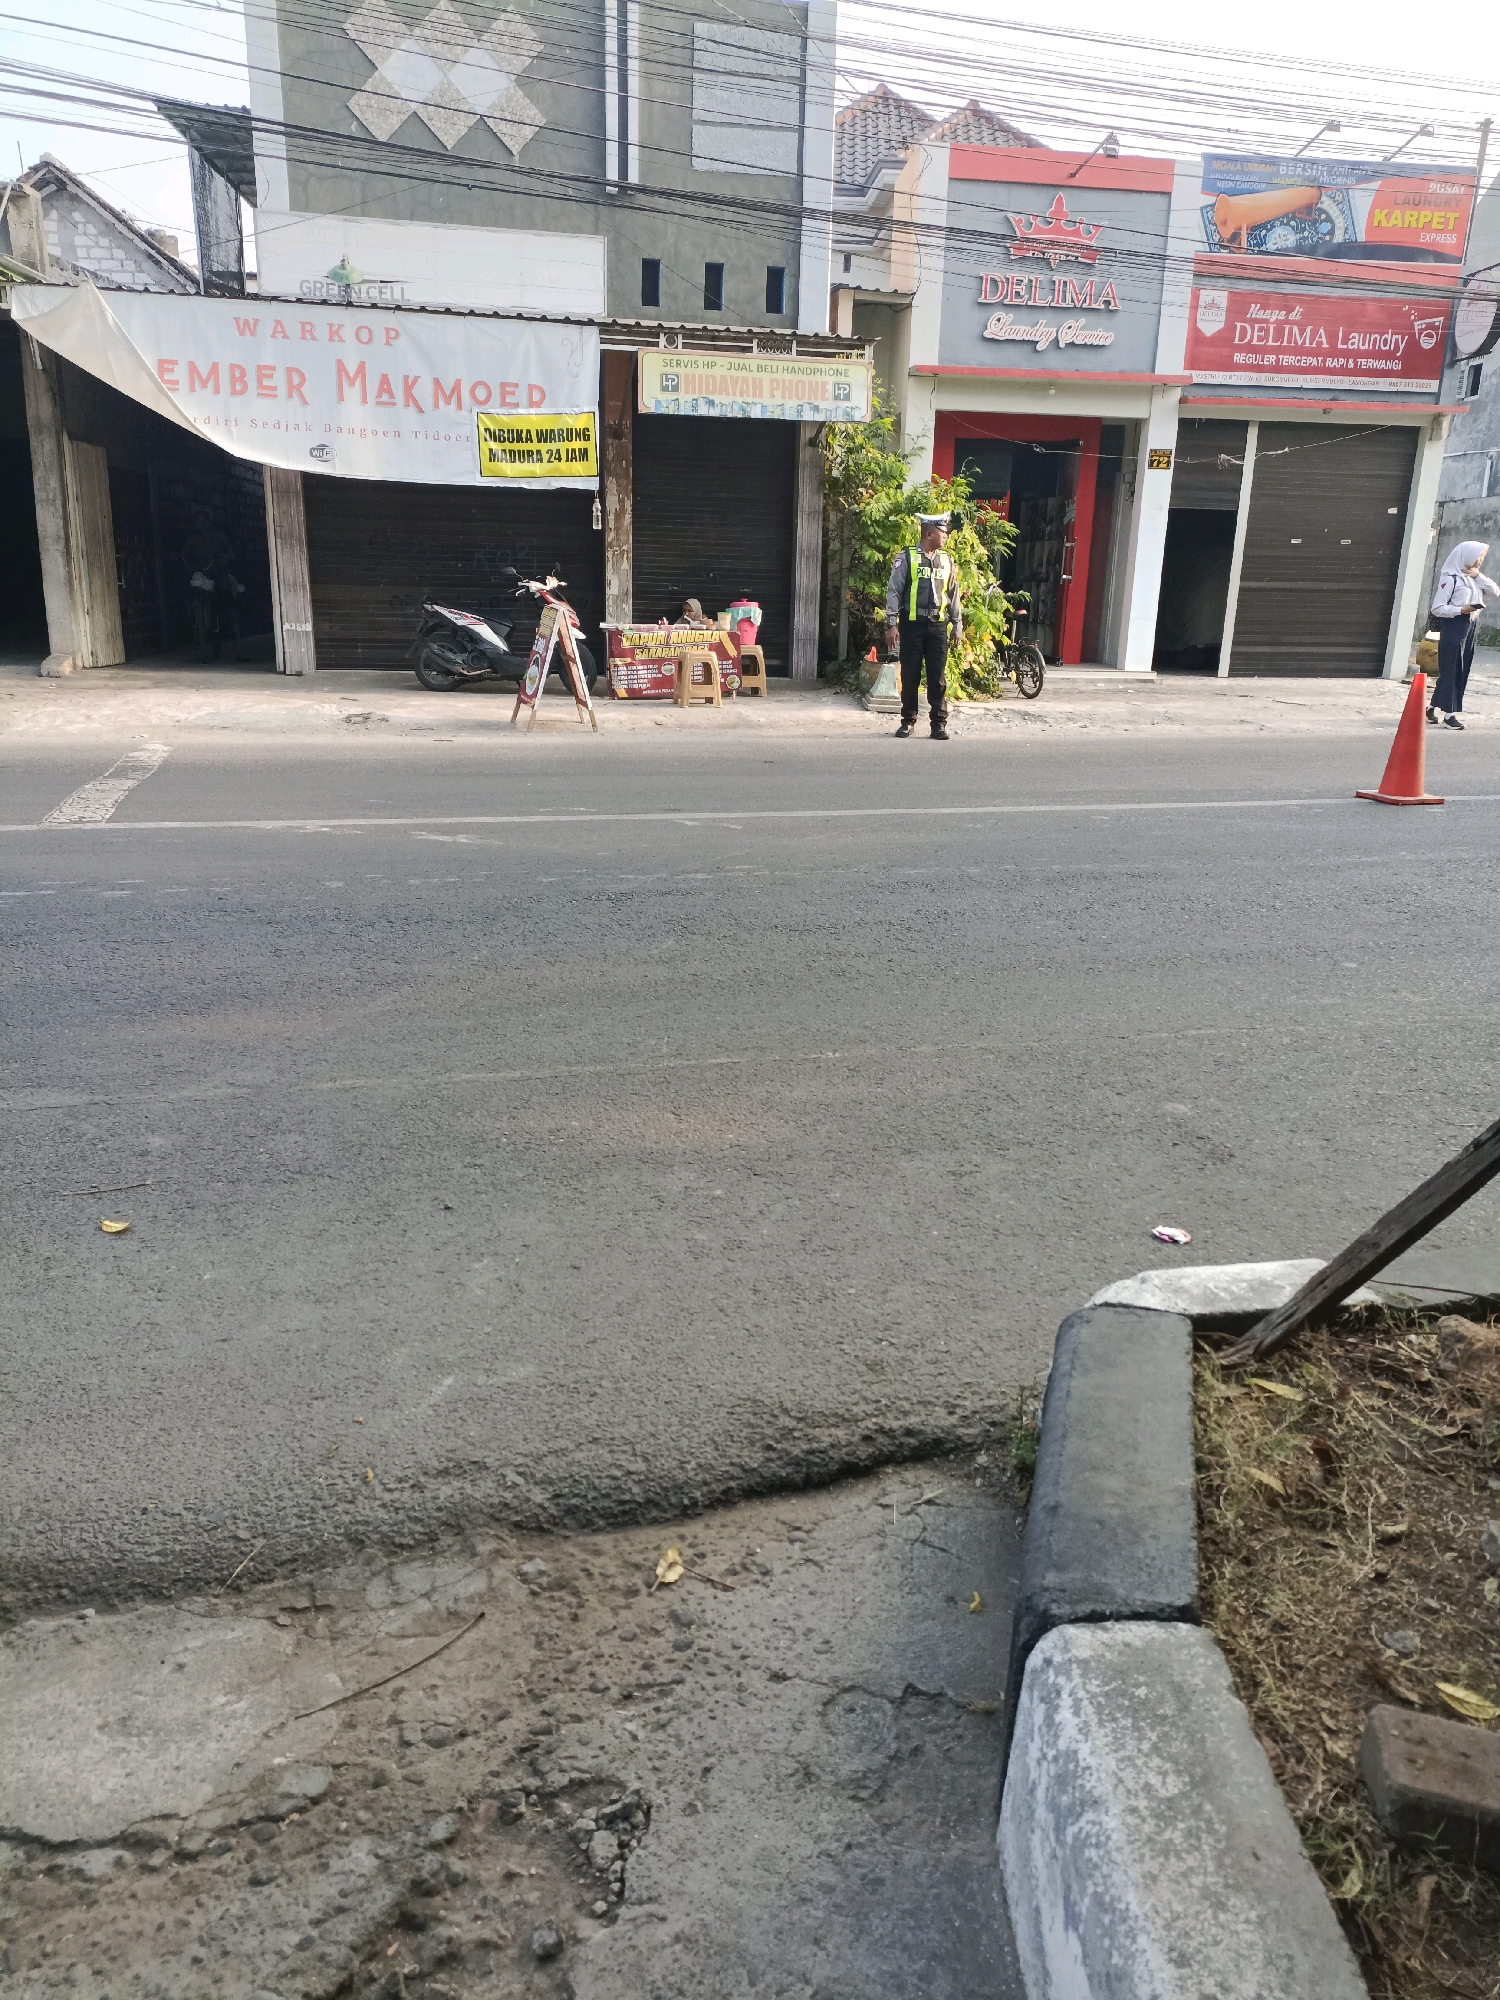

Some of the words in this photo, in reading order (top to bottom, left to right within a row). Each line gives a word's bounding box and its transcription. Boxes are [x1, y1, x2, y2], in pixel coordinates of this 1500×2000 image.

[1211, 161, 1241, 171] SEGALA
[1393, 195, 1462, 208] LAUNDRY
[1372, 208, 1460, 230] KARPET
[1419, 232, 1457, 243] EXPRESS
[299, 280, 361, 300] GREEN
[366, 285, 411, 303] CELL
[978, 272, 1121, 310] DELIMA
[1247, 303, 1287, 321] Hanya
[1288, 307, 1303, 320] di
[233, 316, 402, 347] WARKOP
[983, 311, 1057, 351] Laundry
[1057, 318, 1115, 348] Service
[1233, 322, 1329, 348] DELIMA
[1338, 327, 1408, 356] Laundry
[662, 358, 699, 369] SERVIS
[702, 360, 717, 370] HP
[726, 362, 753, 373] JUAL
[757, 364, 779, 374] BELI
[782, 365, 850, 378] HANDPHONE
[1233, 353, 1276, 366] REGULER
[1325, 358, 1347, 369] RAPI
[1347, 359, 1355, 369] &
[1356, 358, 1402, 371] TERWANGI
[683, 373, 764, 399] HIDAYAH
[769, 378, 830, 401] PHONE
[250, 418, 312, 433] Sedjak
[323, 423, 401, 439] Bangoen
[484, 428, 534, 444] DIBUKA
[536, 427, 591, 443] WARUNG
[488, 448, 544, 464] MADURA
[546, 449, 562, 463] 24
[565, 447, 589, 463] JAM
[1152, 456, 1168, 468] 72
[621, 631, 668, 649] DAPUR
